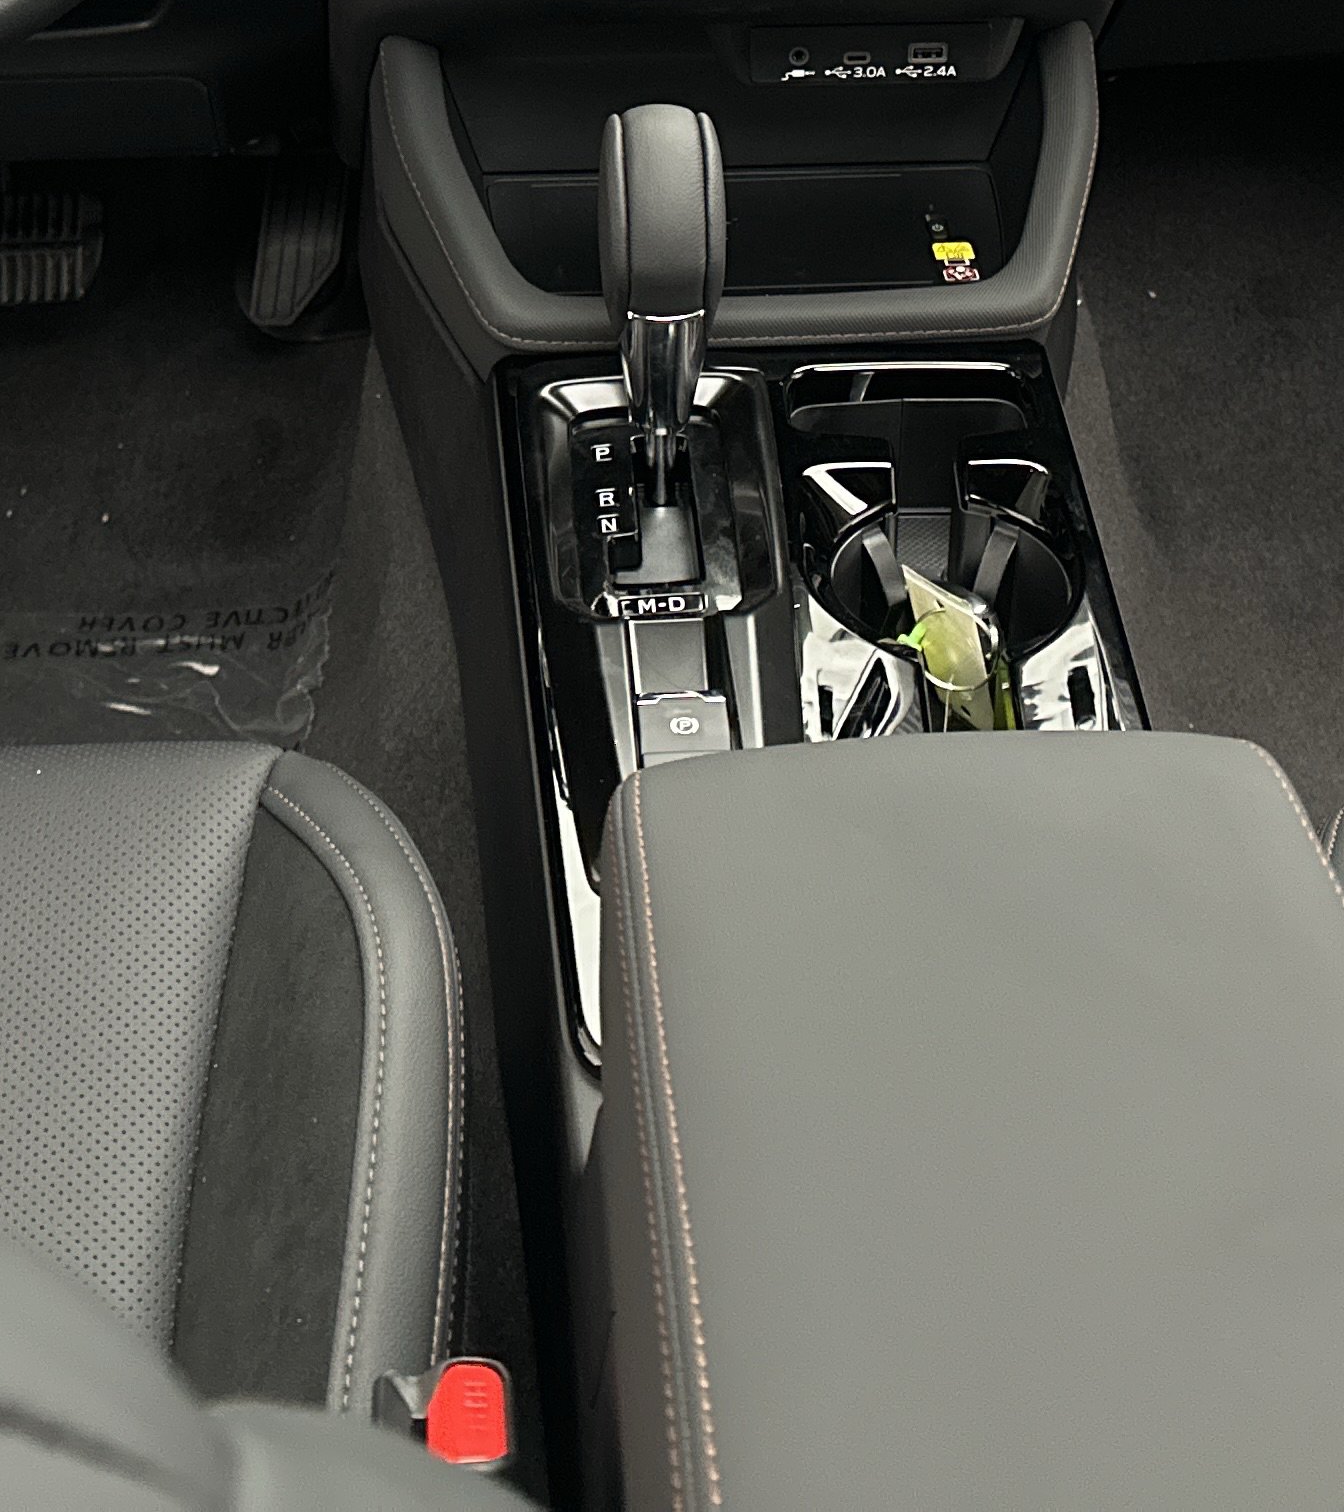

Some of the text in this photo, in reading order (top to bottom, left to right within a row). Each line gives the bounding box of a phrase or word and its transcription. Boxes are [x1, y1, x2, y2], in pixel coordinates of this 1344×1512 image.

[853, 66, 886, 78] 3.0A
[924, 66, 956, 76] 2.4A
[595, 446, 612, 461] P
[599, 492, 615, 507] R
[601, 518, 617, 533] N
